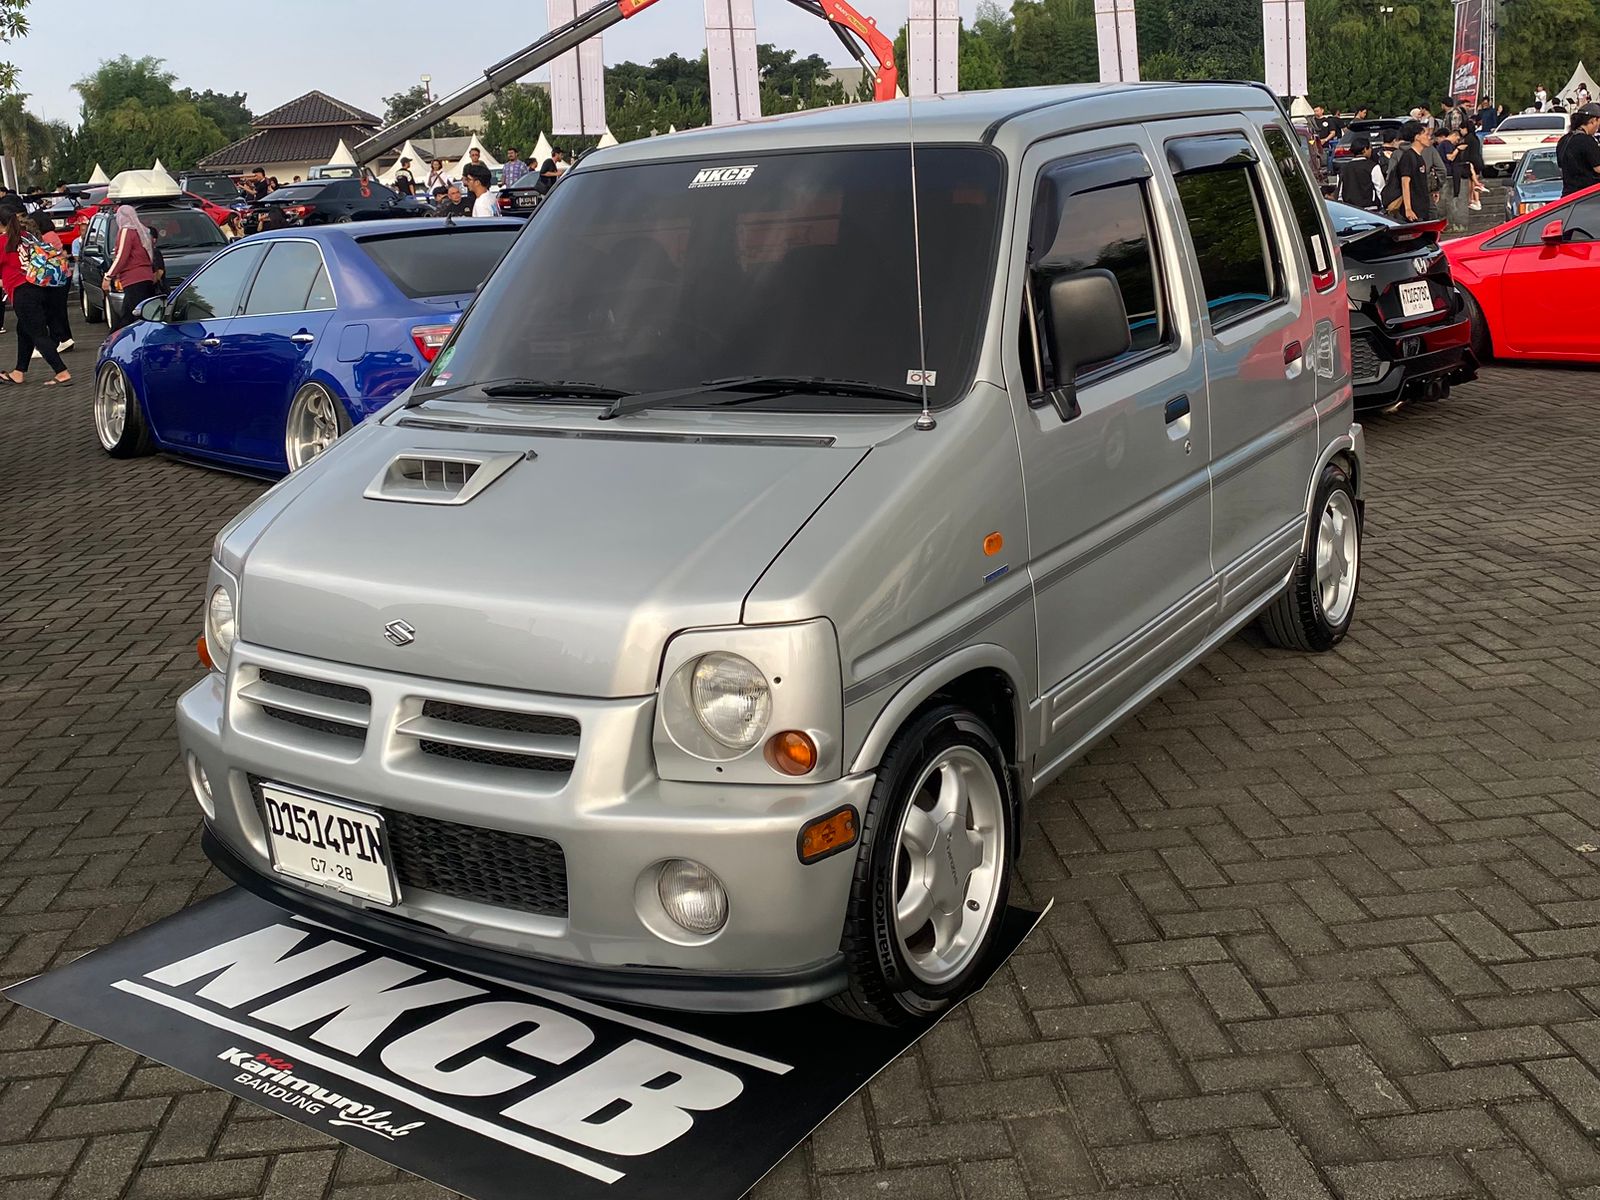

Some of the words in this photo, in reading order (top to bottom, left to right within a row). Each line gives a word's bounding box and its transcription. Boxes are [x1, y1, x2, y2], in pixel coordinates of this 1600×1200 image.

[692, 167, 755, 183] NKCB
[1349, 273, 1375, 281] CIVIC
[911, 374, 932, 383] OK
[265, 797, 386, 866] D1514PIN
[143, 923, 744, 1156] NKCB
[256, 1053, 293, 1070] neo
[217, 1047, 362, 1115] Karimun
[234, 1072, 325, 1115] BANDUNG
